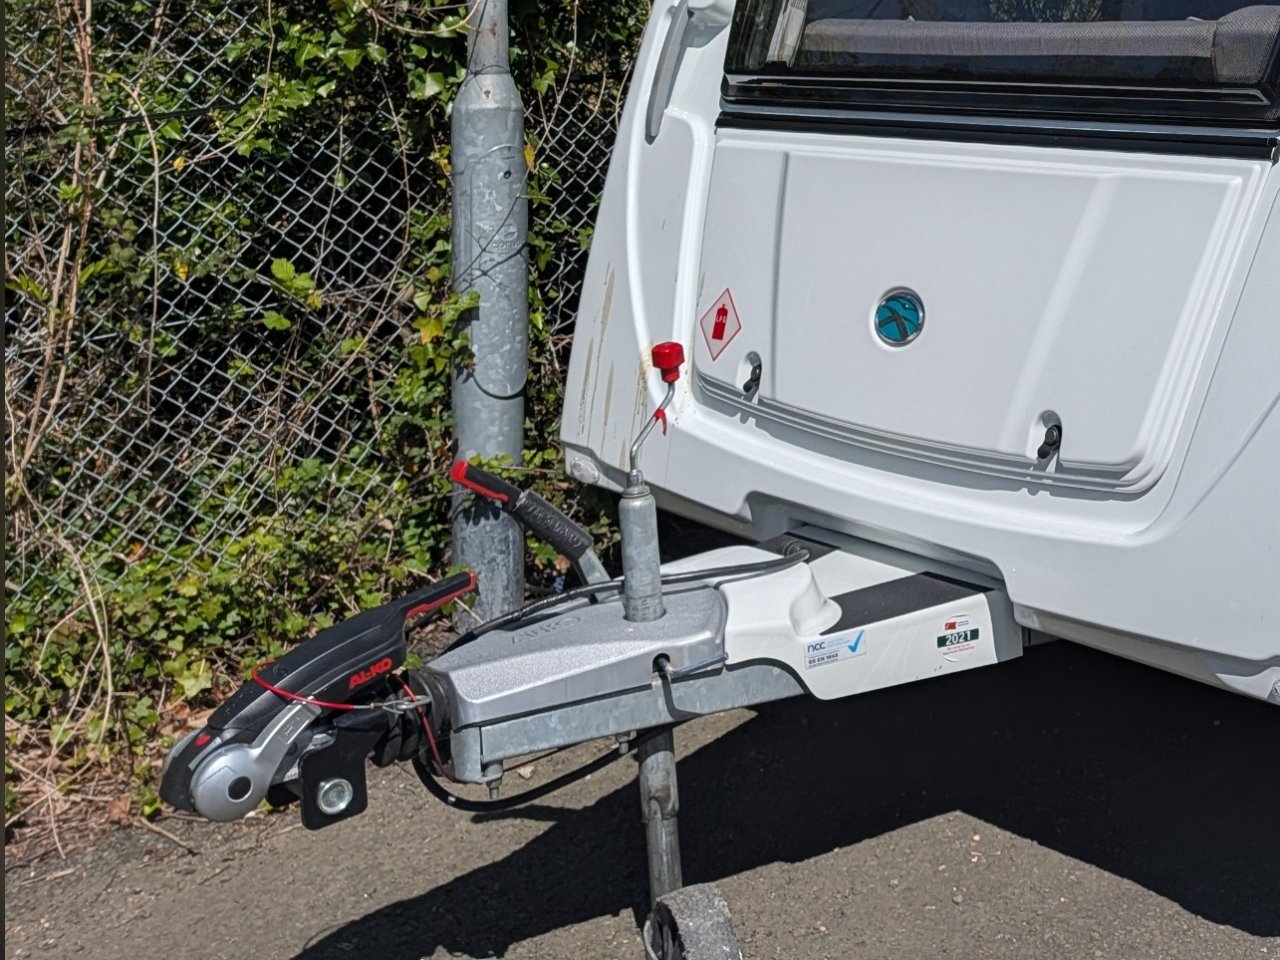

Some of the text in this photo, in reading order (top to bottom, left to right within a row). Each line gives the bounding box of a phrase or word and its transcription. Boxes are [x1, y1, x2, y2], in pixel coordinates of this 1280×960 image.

[945, 630, 971, 646] 2021
[807, 641, 826, 653] ncc
[349, 657, 392, 690] AL-KO
